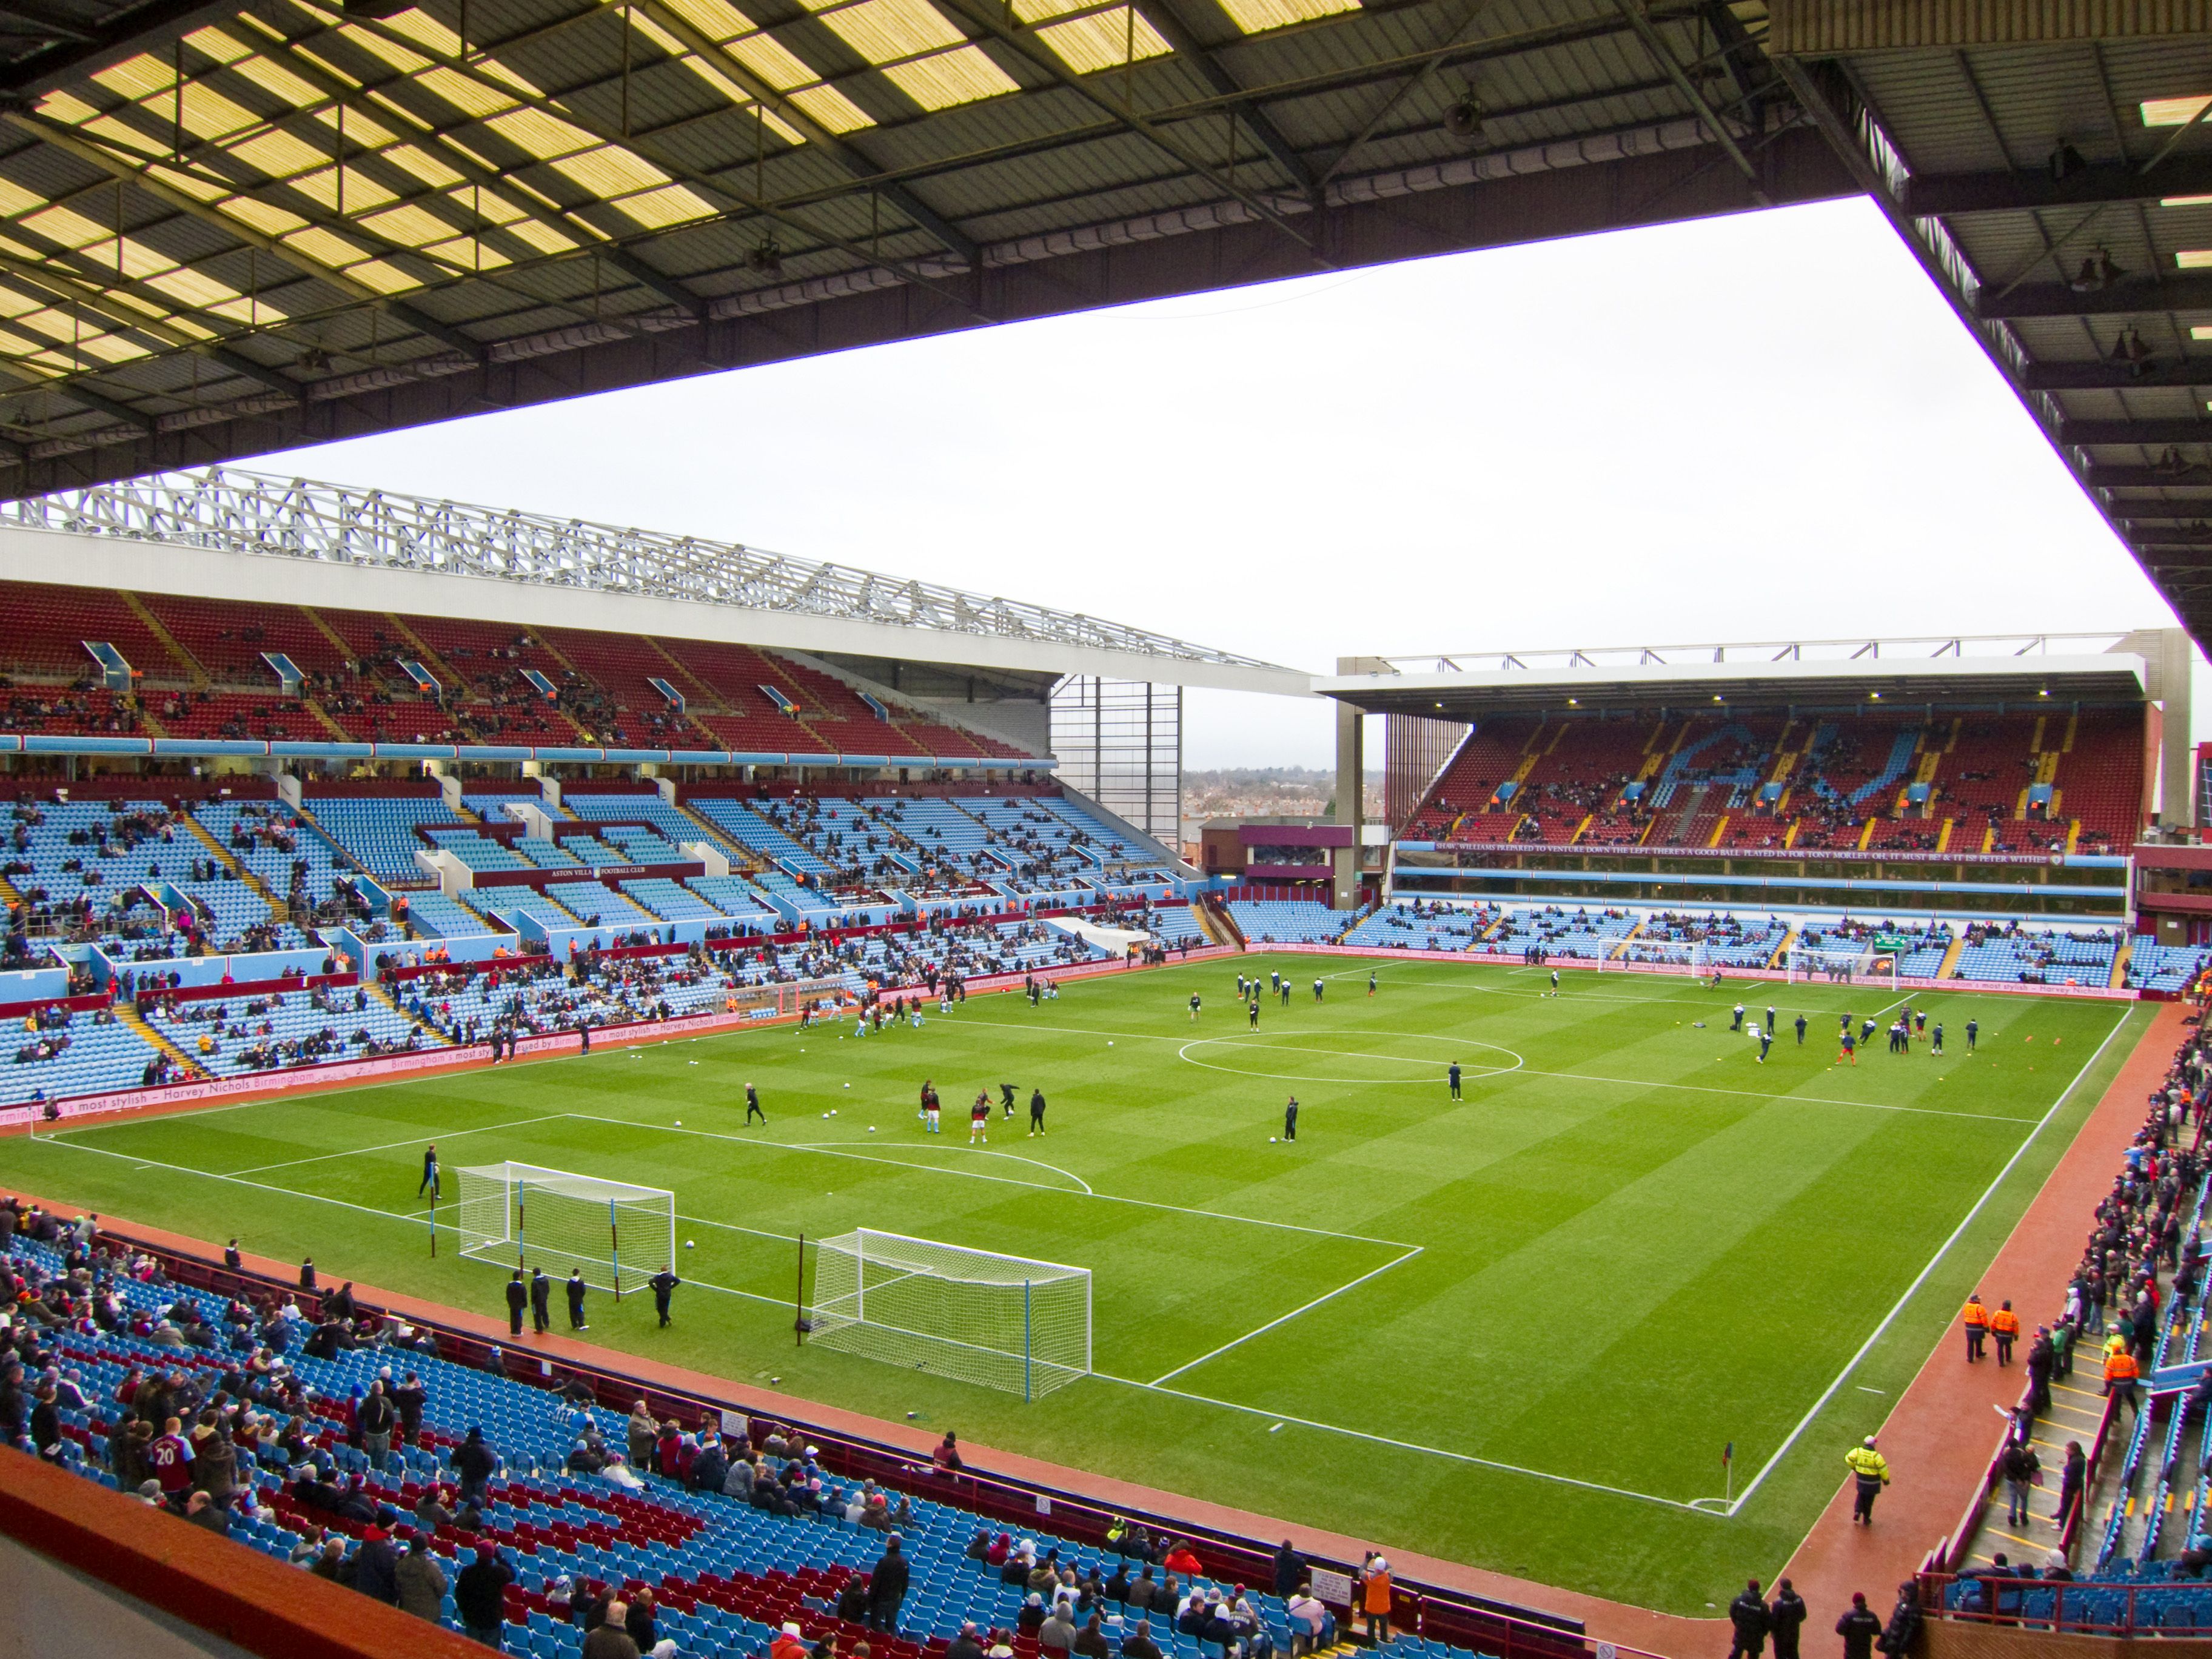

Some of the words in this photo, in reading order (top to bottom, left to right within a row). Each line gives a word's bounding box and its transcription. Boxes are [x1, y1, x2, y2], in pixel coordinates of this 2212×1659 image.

[1855, 976, 1879, 984] stylish
[1914, 978, 1923, 987] by
[1926, 979, 1979, 989] Birmingham's
[2003, 983, 2028, 991] stylish
[2040, 985, 2070, 994] Harvey
[2073, 987, 2104, 995] Nichols
[542, 1039, 552, 1049] by
[609, 1029, 626, 1039] most
[629, 1024, 650, 1037] stylish
[661, 1022, 685, 1031] Harvey
[689, 1016, 713, 1027] Nichols
[392, 1052, 452, 1068] Birmingham's
[456, 1049, 475, 1059] most
[79, 1099, 106, 1111] most
[112, 1091, 146, 1108] stylish
[164, 1088, 204, 1100] Harvey
[209, 1078, 250, 1093] Nichols
[255, 1071, 314, 1087] Birmingham
[157, 1447, 174, 1465] 20
